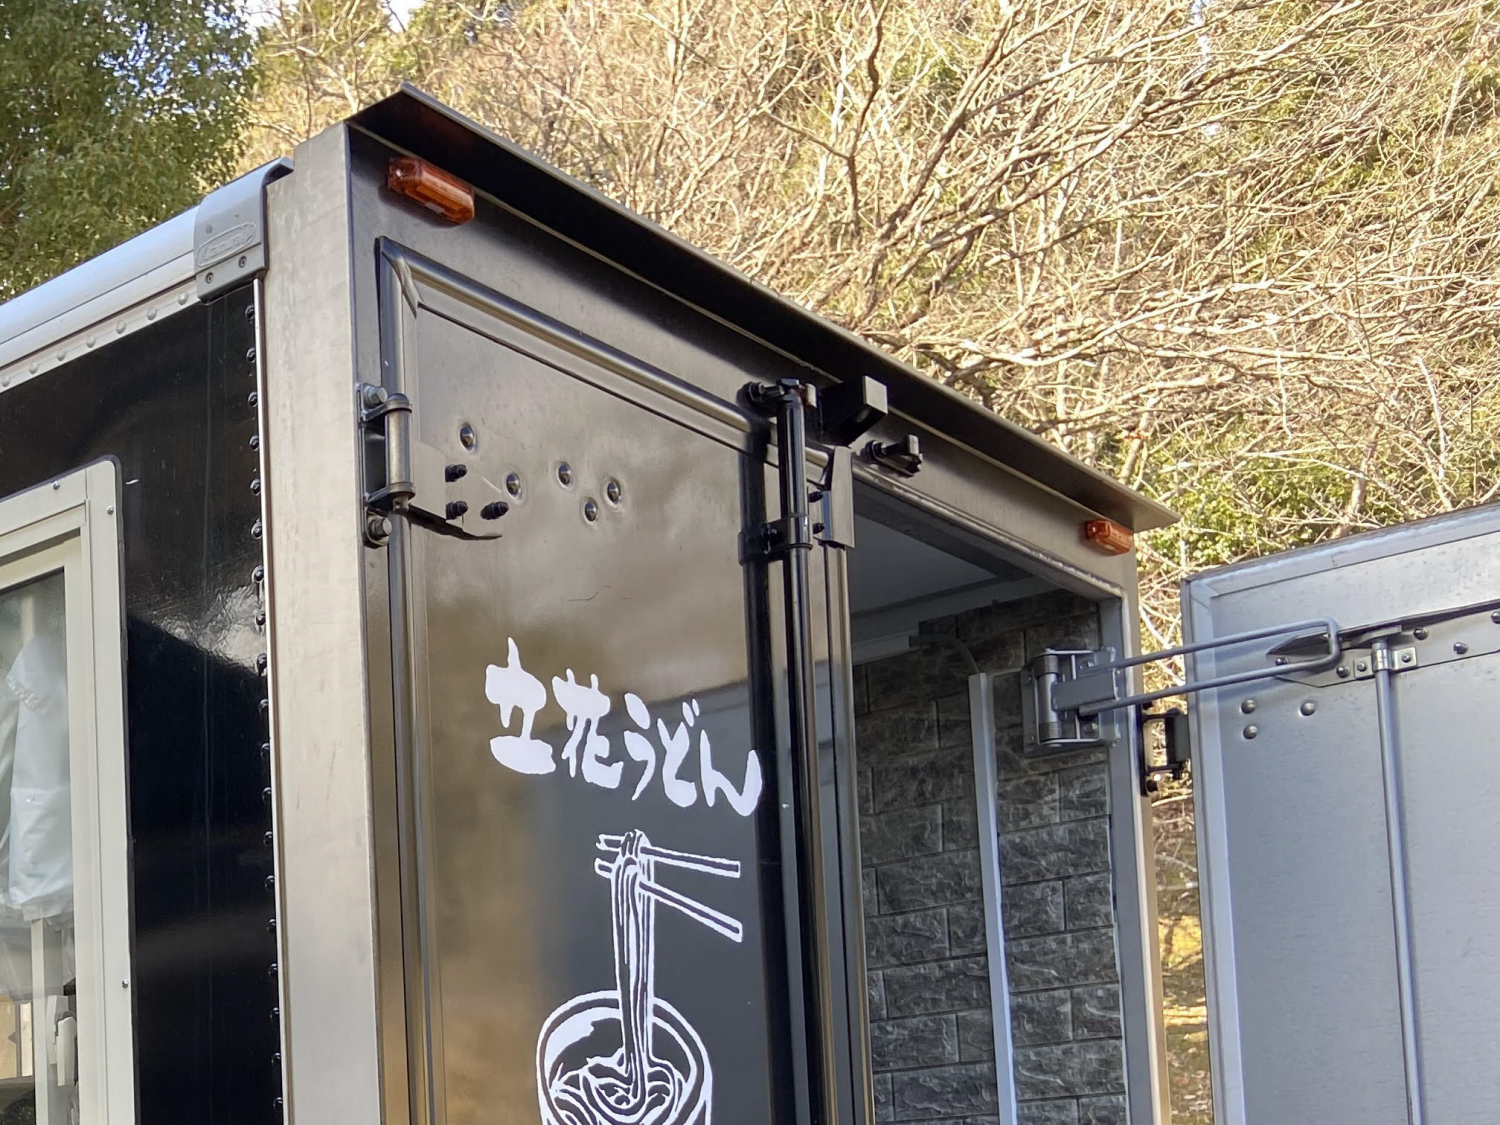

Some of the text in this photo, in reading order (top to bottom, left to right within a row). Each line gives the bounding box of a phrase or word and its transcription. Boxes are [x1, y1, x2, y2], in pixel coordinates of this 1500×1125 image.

[485, 636, 763, 817] 立花うどん
